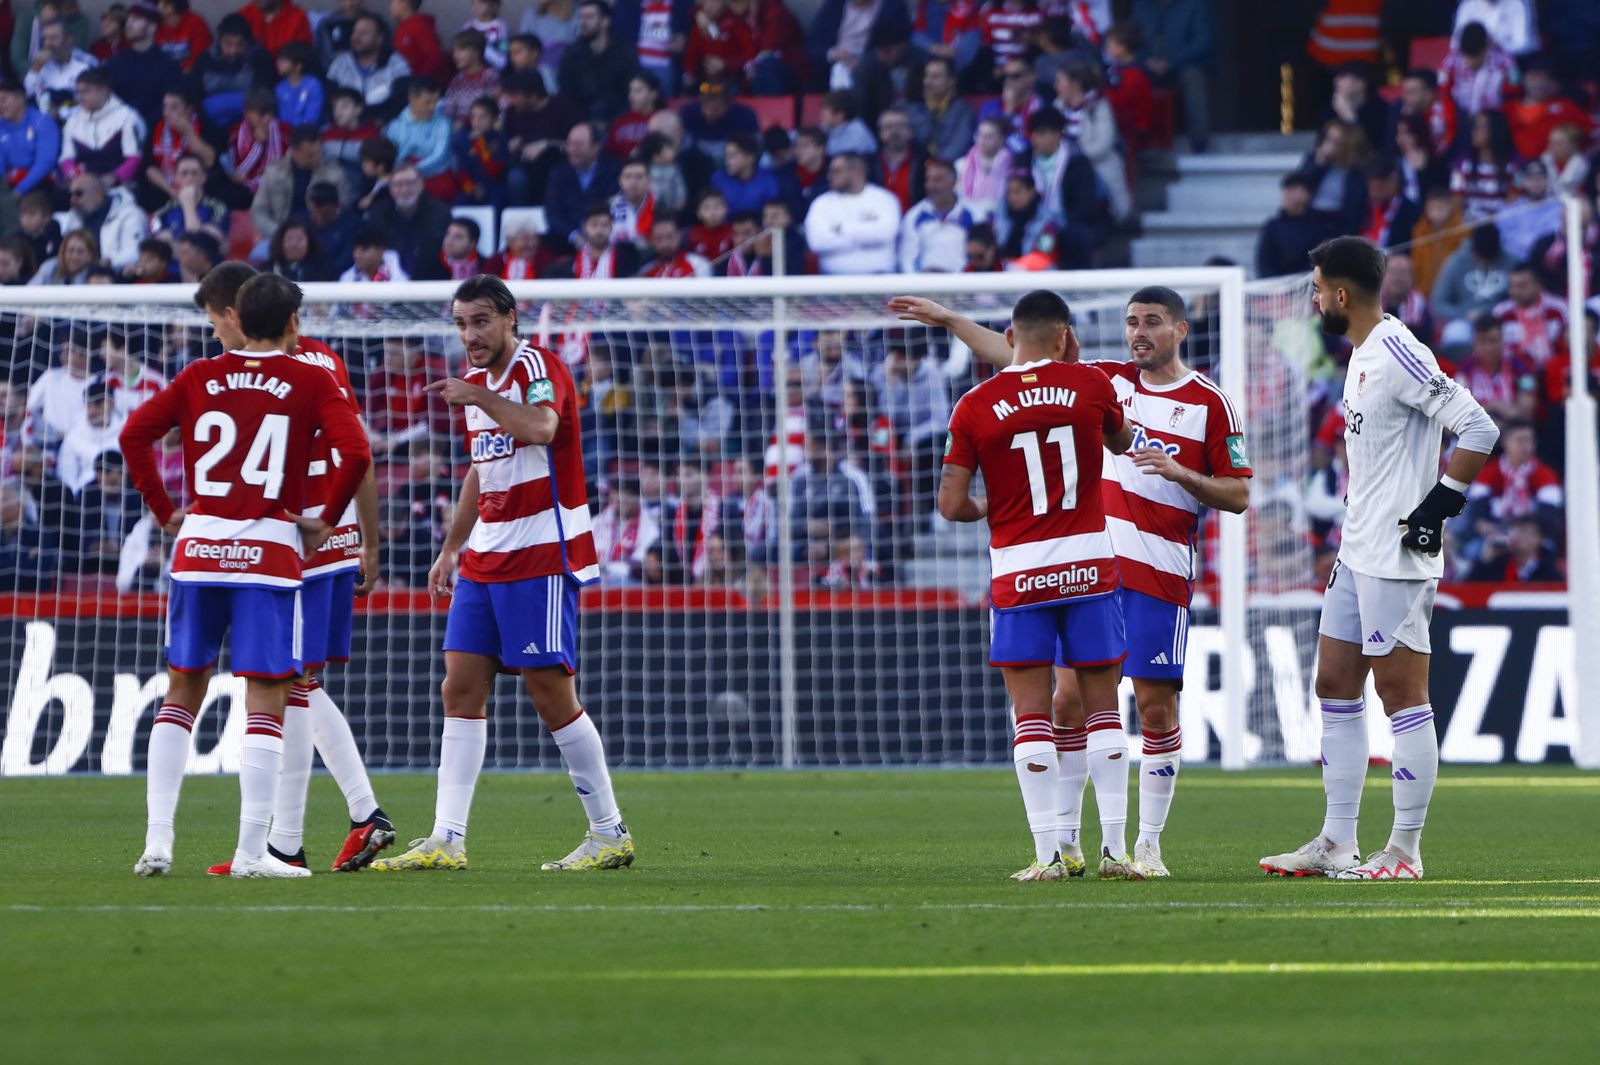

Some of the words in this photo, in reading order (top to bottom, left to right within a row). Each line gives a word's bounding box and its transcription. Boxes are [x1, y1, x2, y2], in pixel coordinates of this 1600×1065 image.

[205, 379, 225, 396] G.
[226, 372, 292, 400] VILLAR
[992, 399, 1019, 421] M.
[1017, 387, 1077, 408] UZUNI
[194, 410, 290, 500] 24
[1010, 425, 1078, 516] 11
[184, 540, 263, 564] Greening
[316, 531, 358, 551] reenin
[219, 560, 248, 570] Group
[1014, 564, 1098, 592] Greening
[1060, 584, 1089, 594] Group
